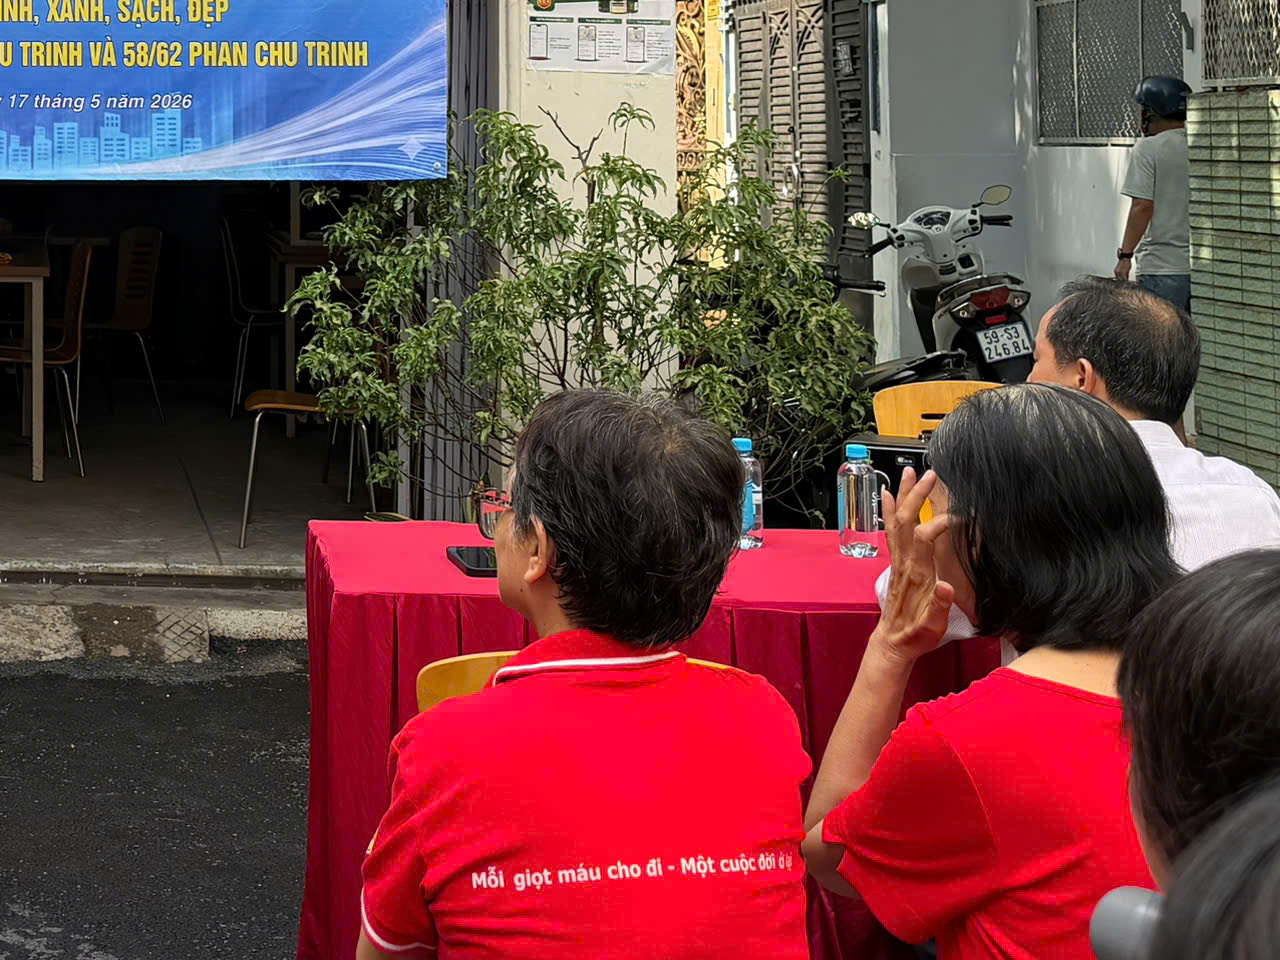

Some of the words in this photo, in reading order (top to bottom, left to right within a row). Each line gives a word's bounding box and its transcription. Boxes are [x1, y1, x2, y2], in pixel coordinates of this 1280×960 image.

[19, 41, 83, 67] TRINH
[89, 37, 117, 67] VÀ
[123, 41, 182, 67] 58/62
[189, 41, 248, 67] PHAN
[255, 41, 298, 67] CHU
[304, 41, 368, 67] TRINH
[11, 95, 28, 107] 17
[35, 95, 84, 111] tháng
[91, 95, 100, 108] 5
[107, 95, 144, 107] năm
[151, 95, 192, 108] 2026
[984, 326, 1020, 345] 59-S3
[472, 867, 504, 888] Mỗi
[514, 869, 552, 891] giọt
[558, 863, 601, 883] máu
[608, 861, 641, 879] cho
[646, 858, 662, 876] đi
[680, 856, 716, 877] Một
[720, 853, 757, 876] cuộc
[758, 852, 776, 871] đời
